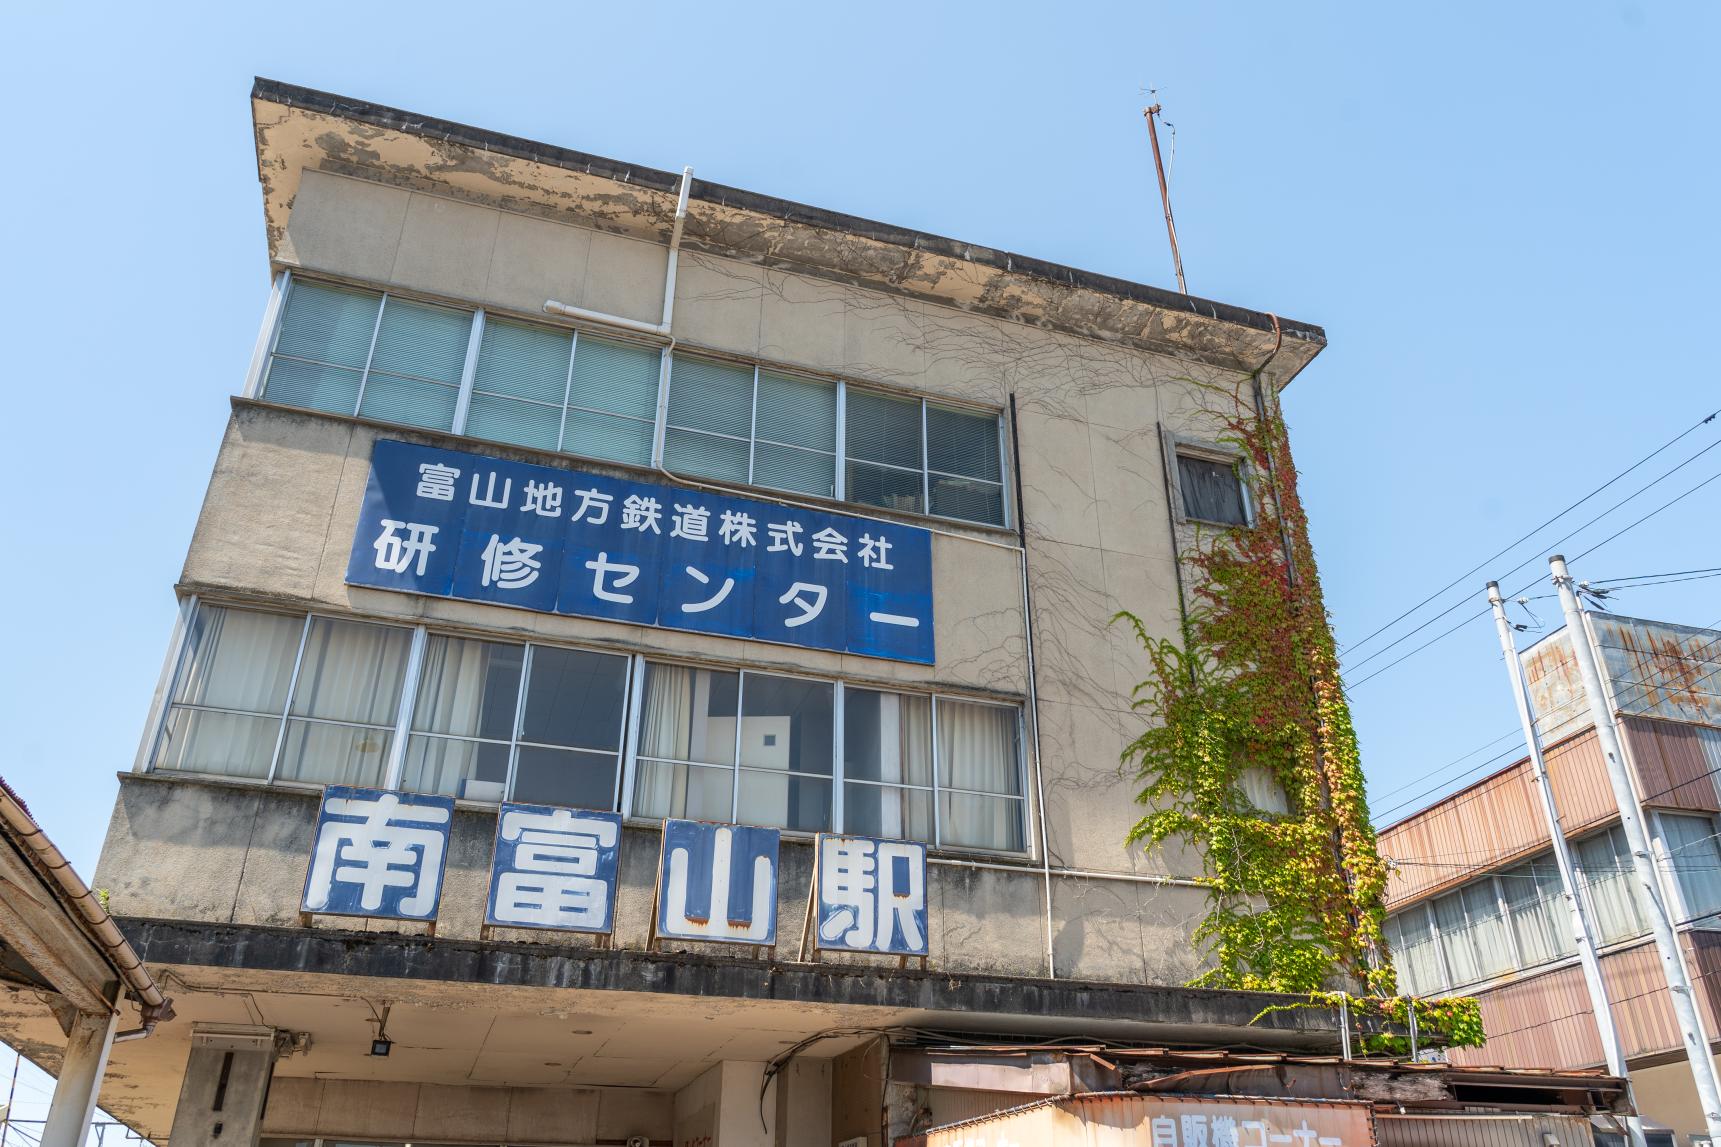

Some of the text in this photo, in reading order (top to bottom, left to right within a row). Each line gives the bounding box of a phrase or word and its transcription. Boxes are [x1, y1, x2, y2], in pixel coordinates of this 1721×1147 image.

[416, 463, 894, 571] 富山地方鉄道株式会社
[374, 519, 920, 627] 研修センター
[306, 793, 927, 952] 南富山駅
[1152, 1115, 1342, 1147] 自販機コーナー
